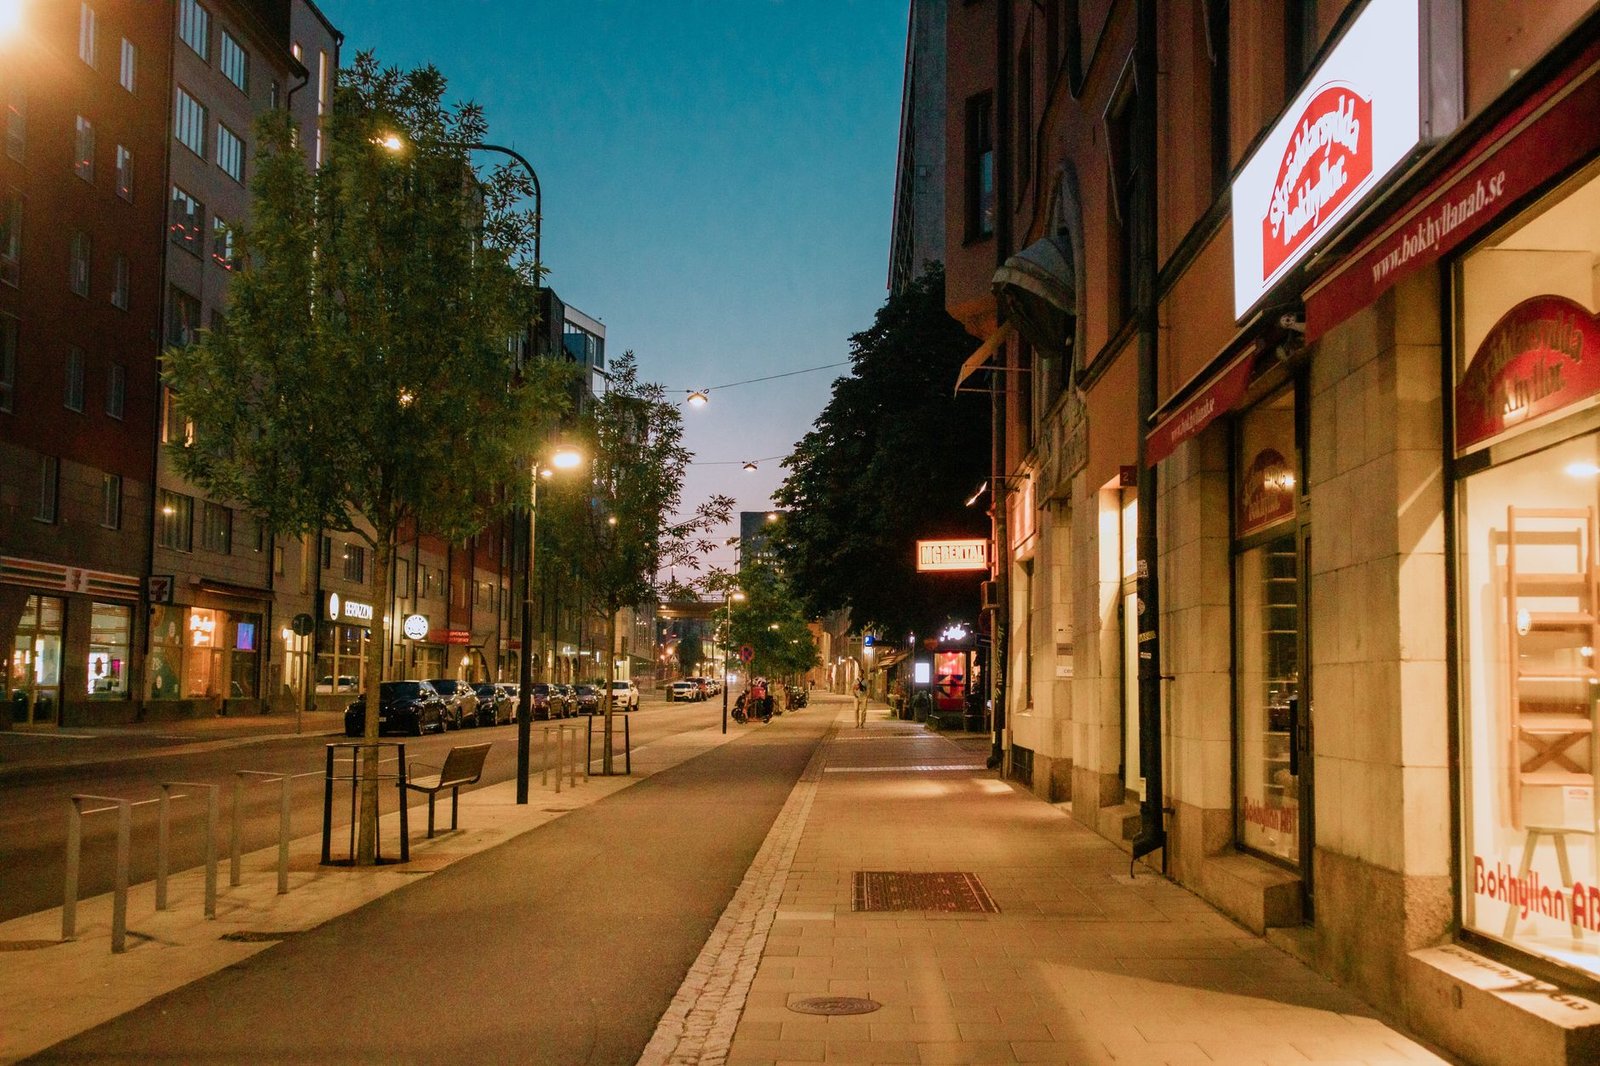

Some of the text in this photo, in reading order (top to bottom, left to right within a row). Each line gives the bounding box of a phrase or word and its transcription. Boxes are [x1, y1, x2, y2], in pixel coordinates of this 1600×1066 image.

[1373, 170, 1505, 284] www.bokhyllanab.se
[1473, 855, 1600, 932] Bokhyllan AB
